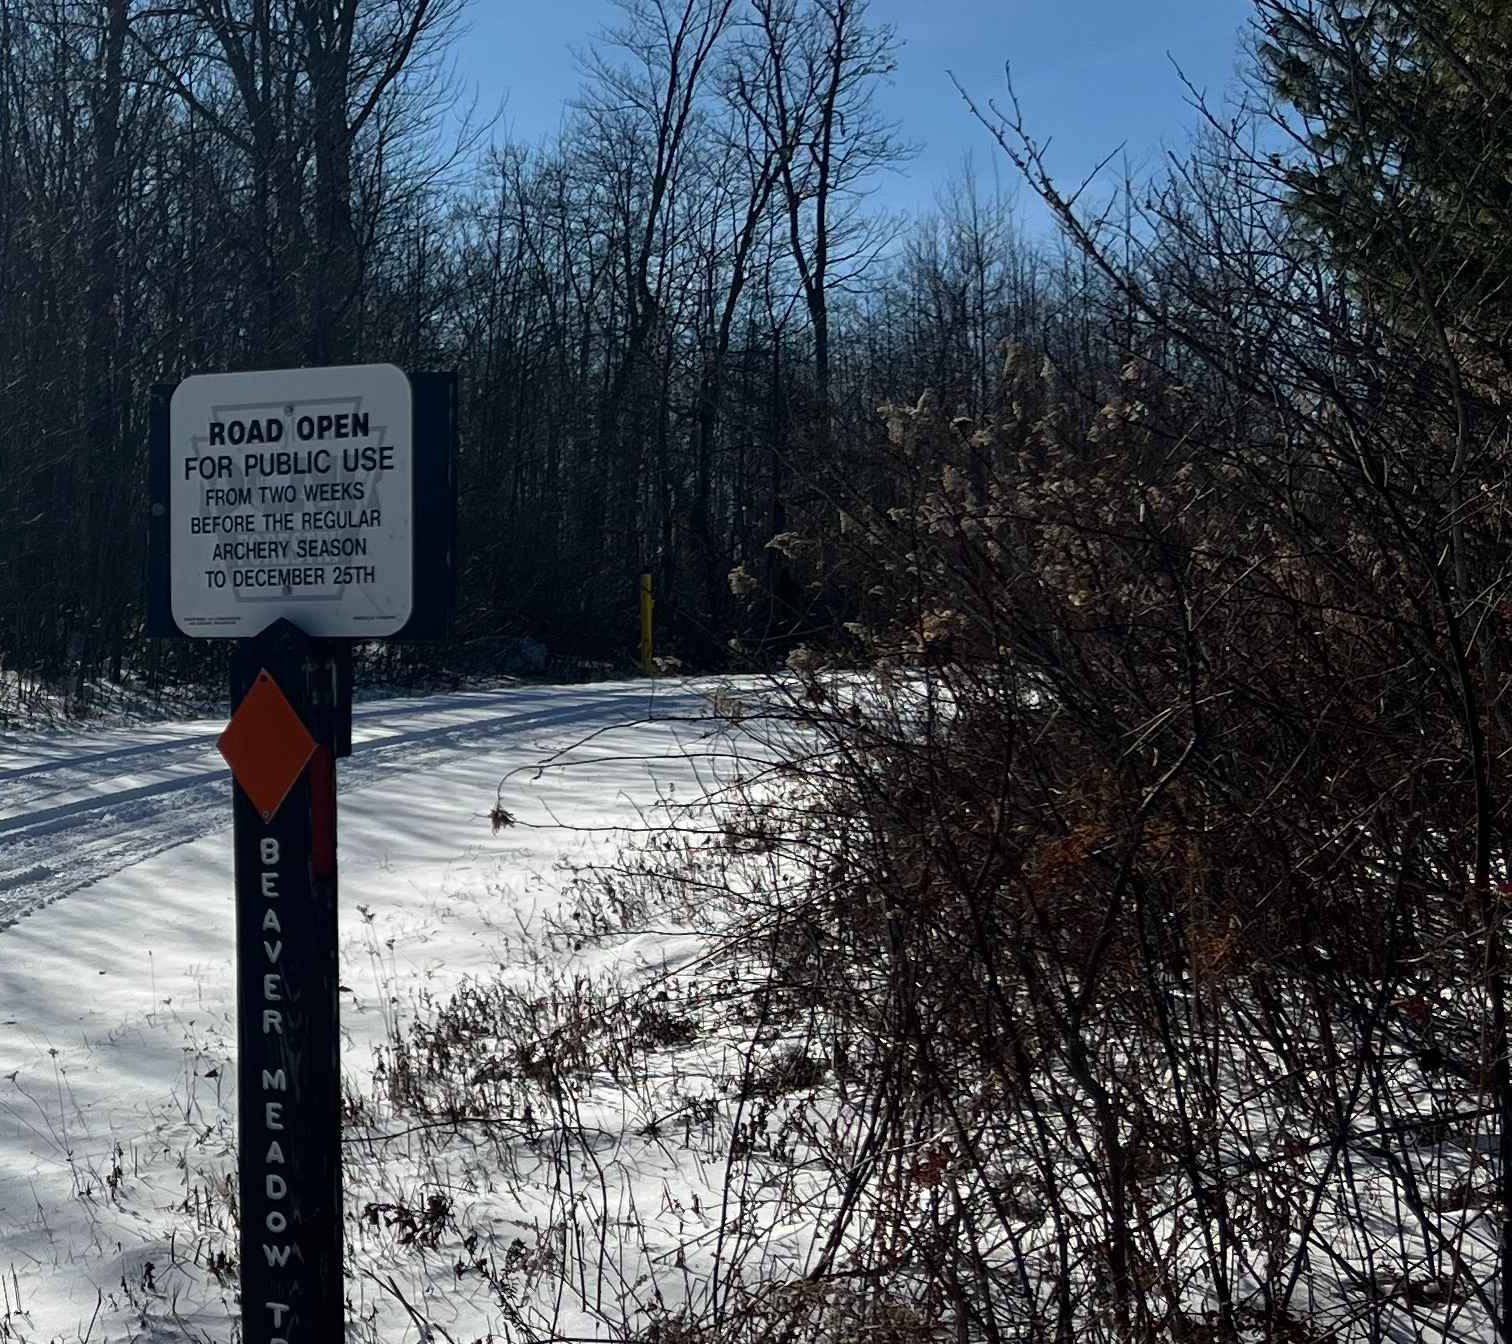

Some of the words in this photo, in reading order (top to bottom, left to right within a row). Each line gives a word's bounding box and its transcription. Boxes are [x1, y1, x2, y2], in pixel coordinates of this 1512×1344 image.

[209, 418, 283, 446] ROAD
[296, 412, 369, 441] OPEN
[184, 456, 233, 480] FOR
[244, 449, 330, 477] PUBLIC
[343, 446, 394, 472] USE
[206, 487, 251, 506] FROM
[259, 485, 296, 504] TWO
[304, 482, 364, 502] WEEKS
[191, 515, 255, 534] BEFORE
[262, 513, 294, 531] THE
[302, 509, 381, 530] REGULAR
[213, 541, 289, 561] ARCHERY
[296, 538, 367, 558] SEASON
[205, 570, 225, 588] TO
[233, 567, 325, 587] DECEMBER
[333, 566, 375, 584] 25TH
[260, 837, 283, 1034] BEAVER
[262, 1068, 291, 1268] MEADOW
